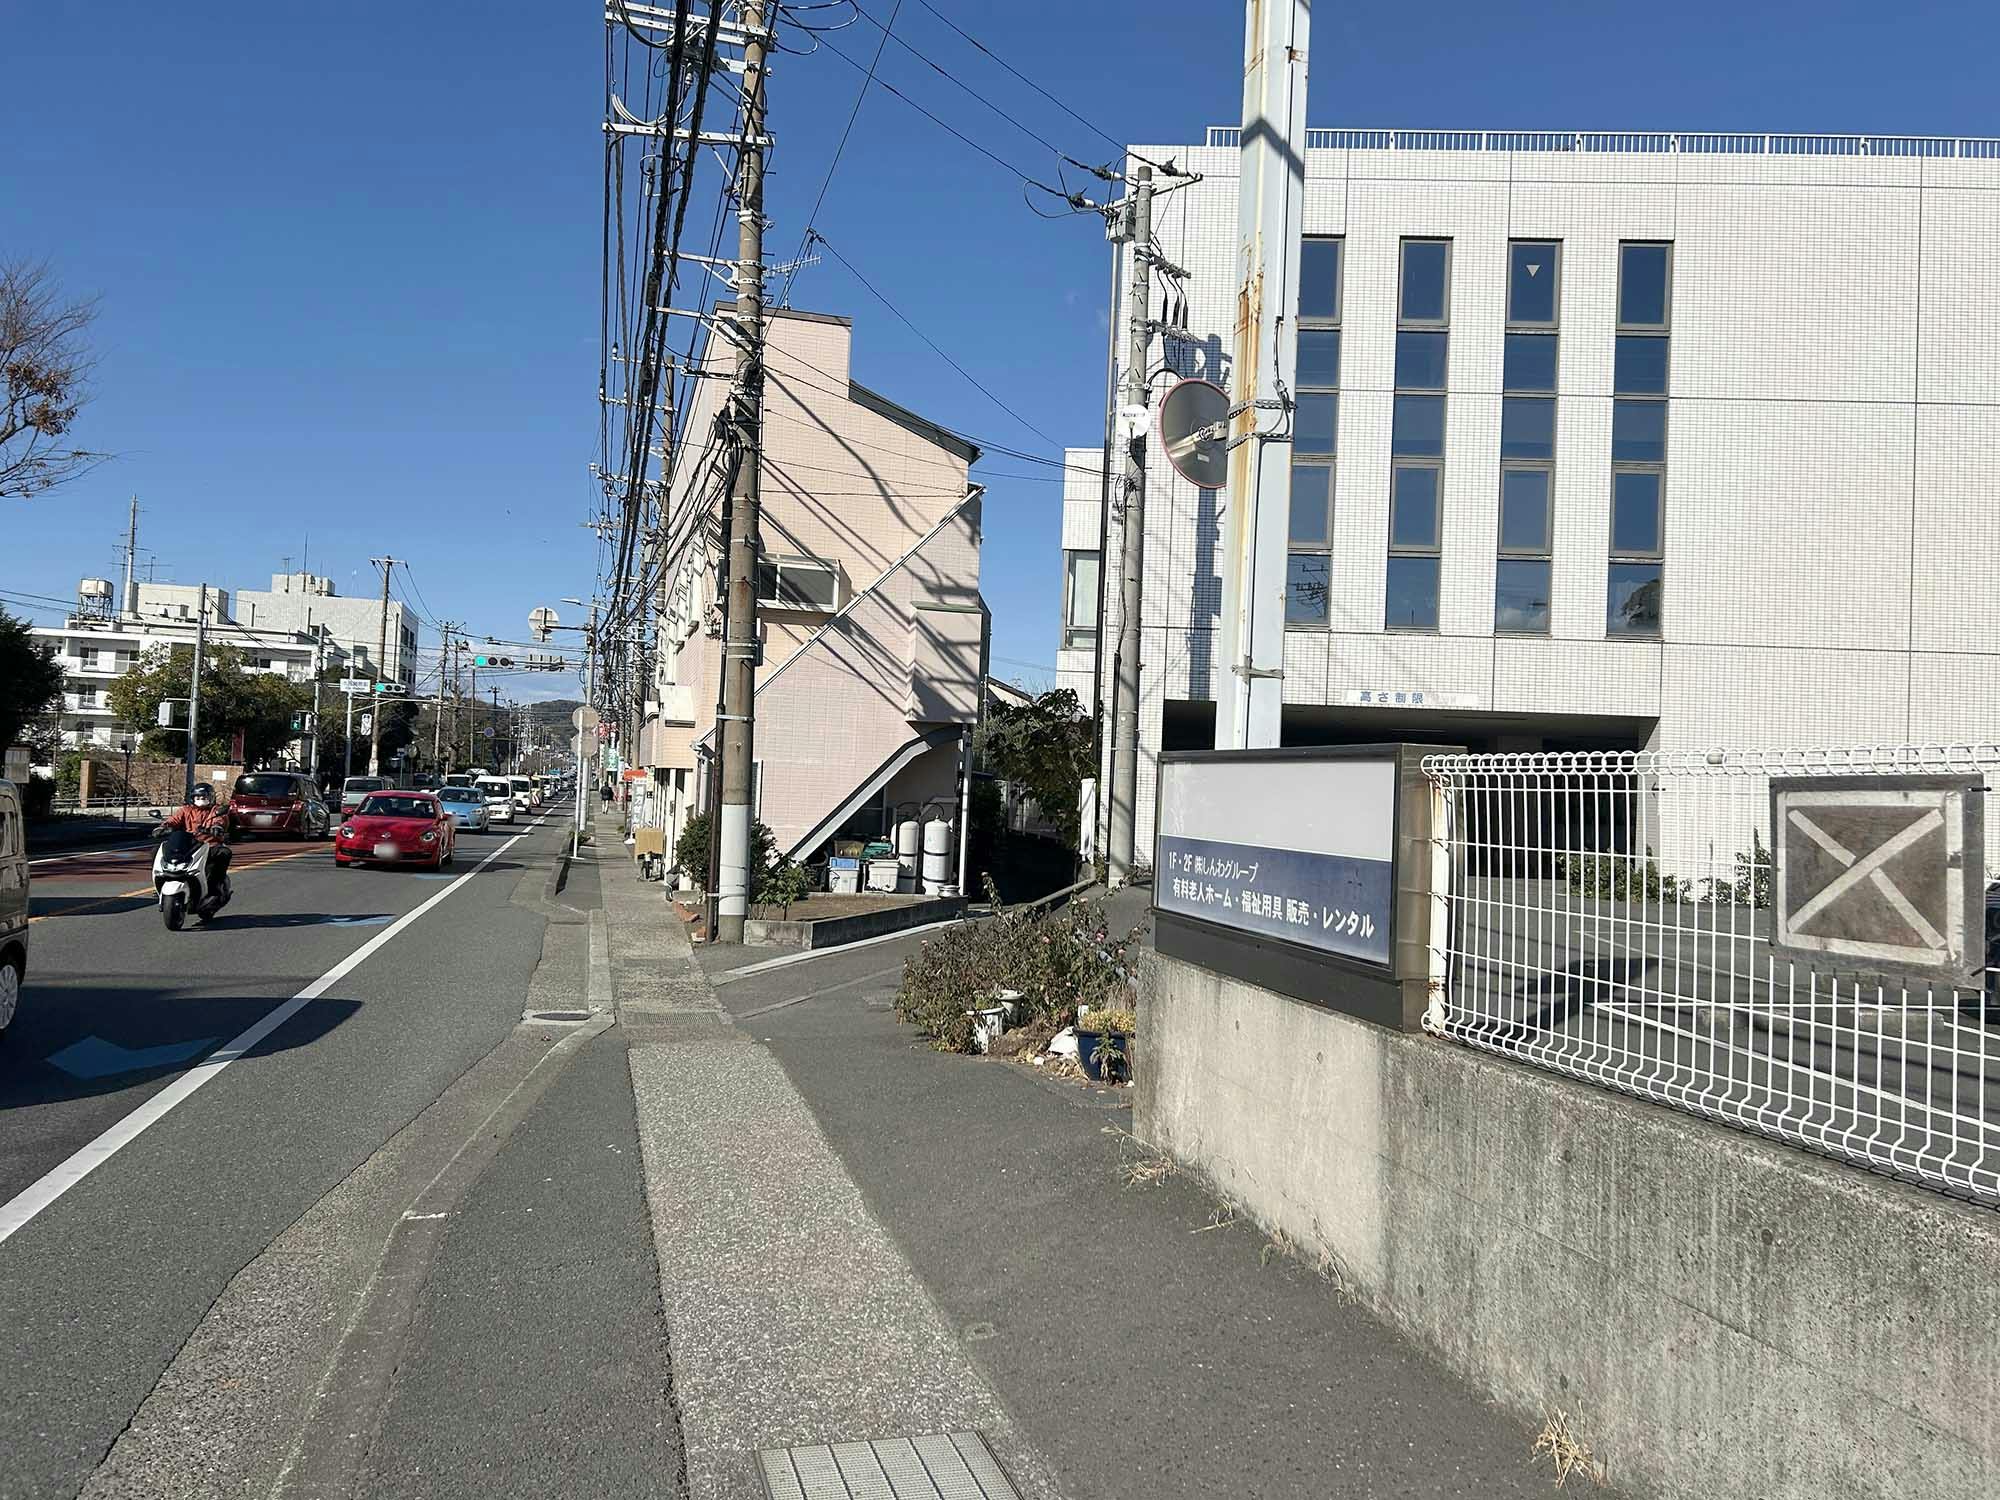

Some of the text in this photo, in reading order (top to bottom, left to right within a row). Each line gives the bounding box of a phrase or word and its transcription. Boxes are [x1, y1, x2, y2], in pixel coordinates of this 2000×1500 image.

[1360, 691, 1424, 704] 高さ制限
[1172, 877, 1376, 940] 有料老人ホーム・福祉用具 販売・レンタル
